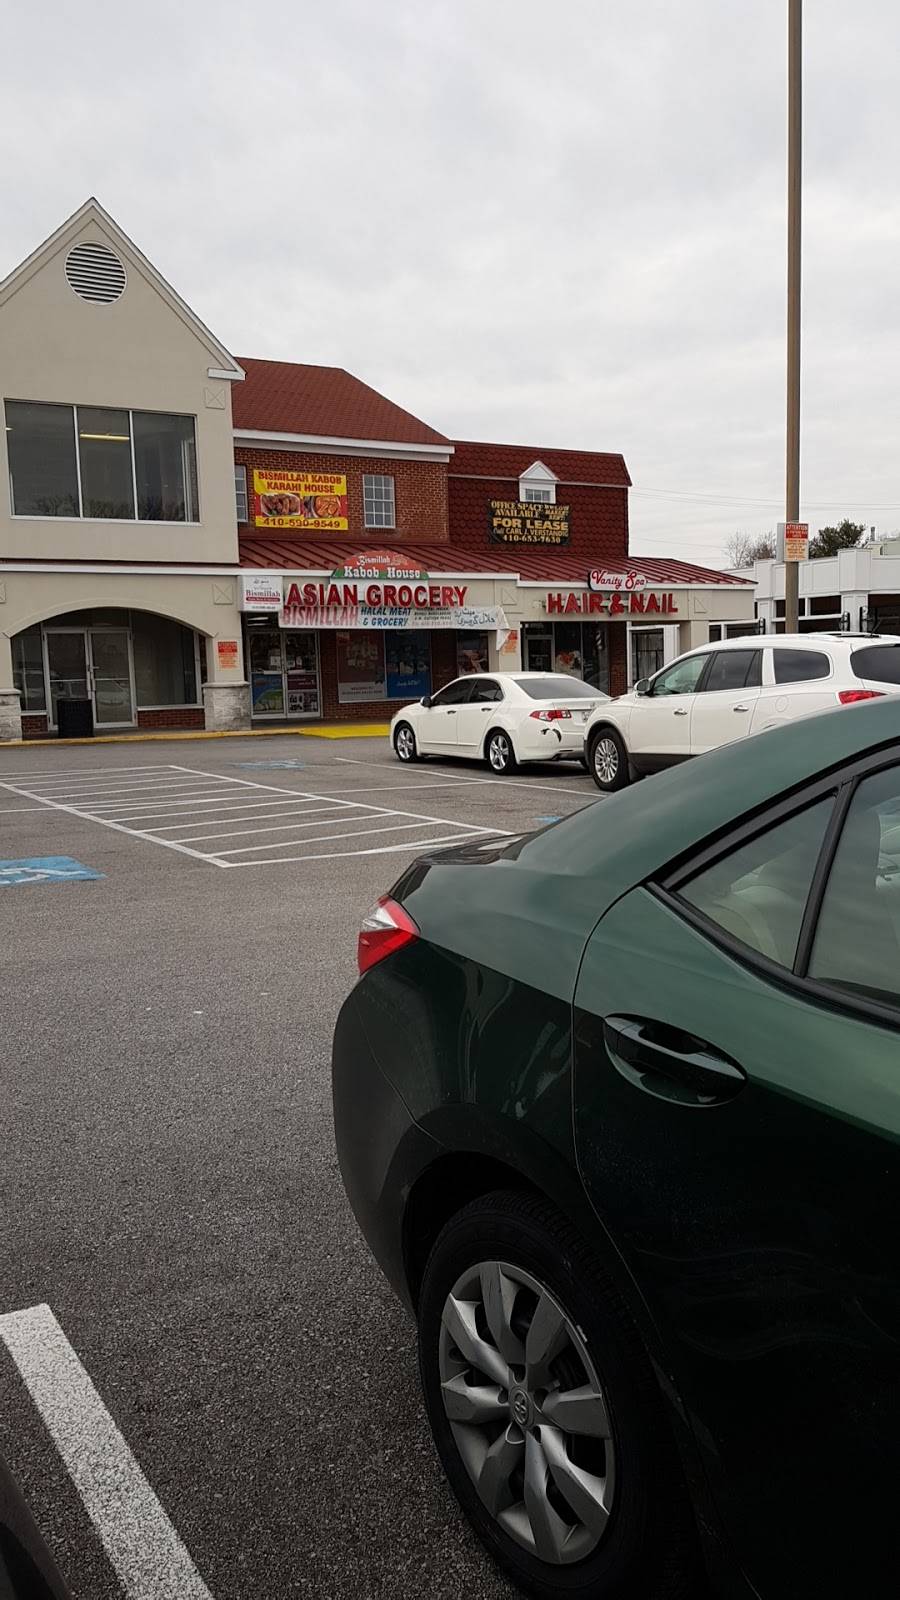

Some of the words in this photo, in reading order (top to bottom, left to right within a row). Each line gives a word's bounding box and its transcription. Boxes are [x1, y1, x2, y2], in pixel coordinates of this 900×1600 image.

[258, 471, 308, 481] BISMILLAH
[311, 475, 342, 484] KABOB
[266, 482, 301, 491] KARAHI
[304, 485, 335, 493] HOUSE
[491, 500, 516, 510] OFFICE
[517, 503, 543, 511] SPACE
[495, 509, 539, 518] AVAILABLE
[493, 518, 522, 528] FOR
[526, 520, 568, 530] LEASE
[503, 535, 561, 543] 410-653-7630
[357, 556, 391, 566] Bismillah
[344, 566, 380, 578] Kabob
[387, 567, 421, 578] House
[591, 571, 623, 589] Vanity
[625, 571, 645, 590] Spa
[286, 583, 358, 606] ASIAN
[366, 584, 468, 608] GROCERY
[546, 593, 604, 614] HAIR
[609, 593, 625, 614] &
[629, 593, 678, 613] NAIL
[282, 606, 359, 626] BISMILLAH
[361, 607, 387, 616] HALAL
[389, 608, 412, 616] MEAT
[371, 618, 408, 626] GROCERY
